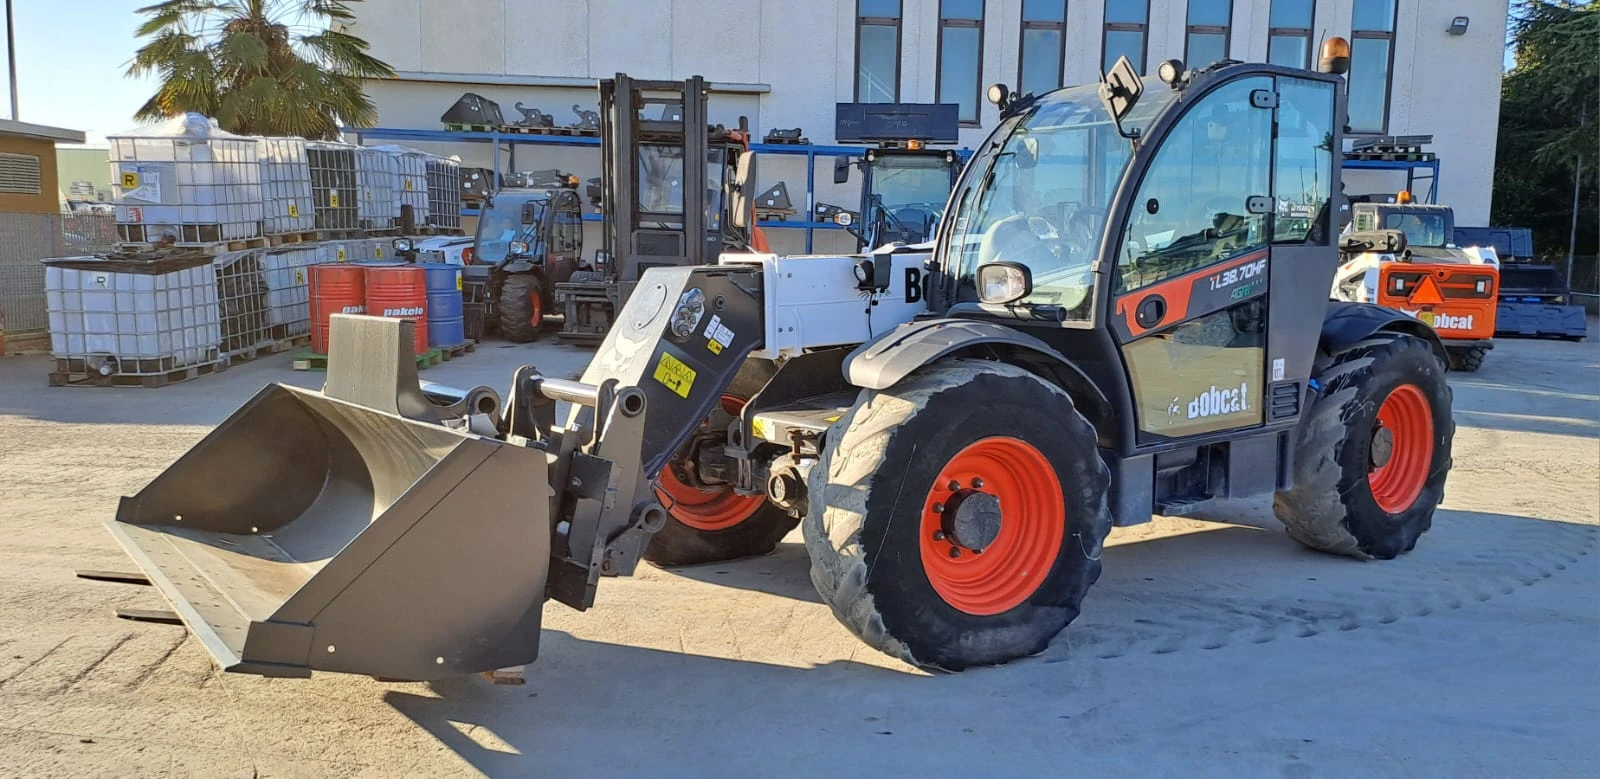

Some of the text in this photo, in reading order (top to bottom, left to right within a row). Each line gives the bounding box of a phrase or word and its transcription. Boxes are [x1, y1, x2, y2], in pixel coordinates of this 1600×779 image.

[124, 174, 134, 186] R
[97, 276, 106, 288] R
[1210, 259, 1266, 291] TL38.70HF
[1433, 312, 1473, 330] obcat
